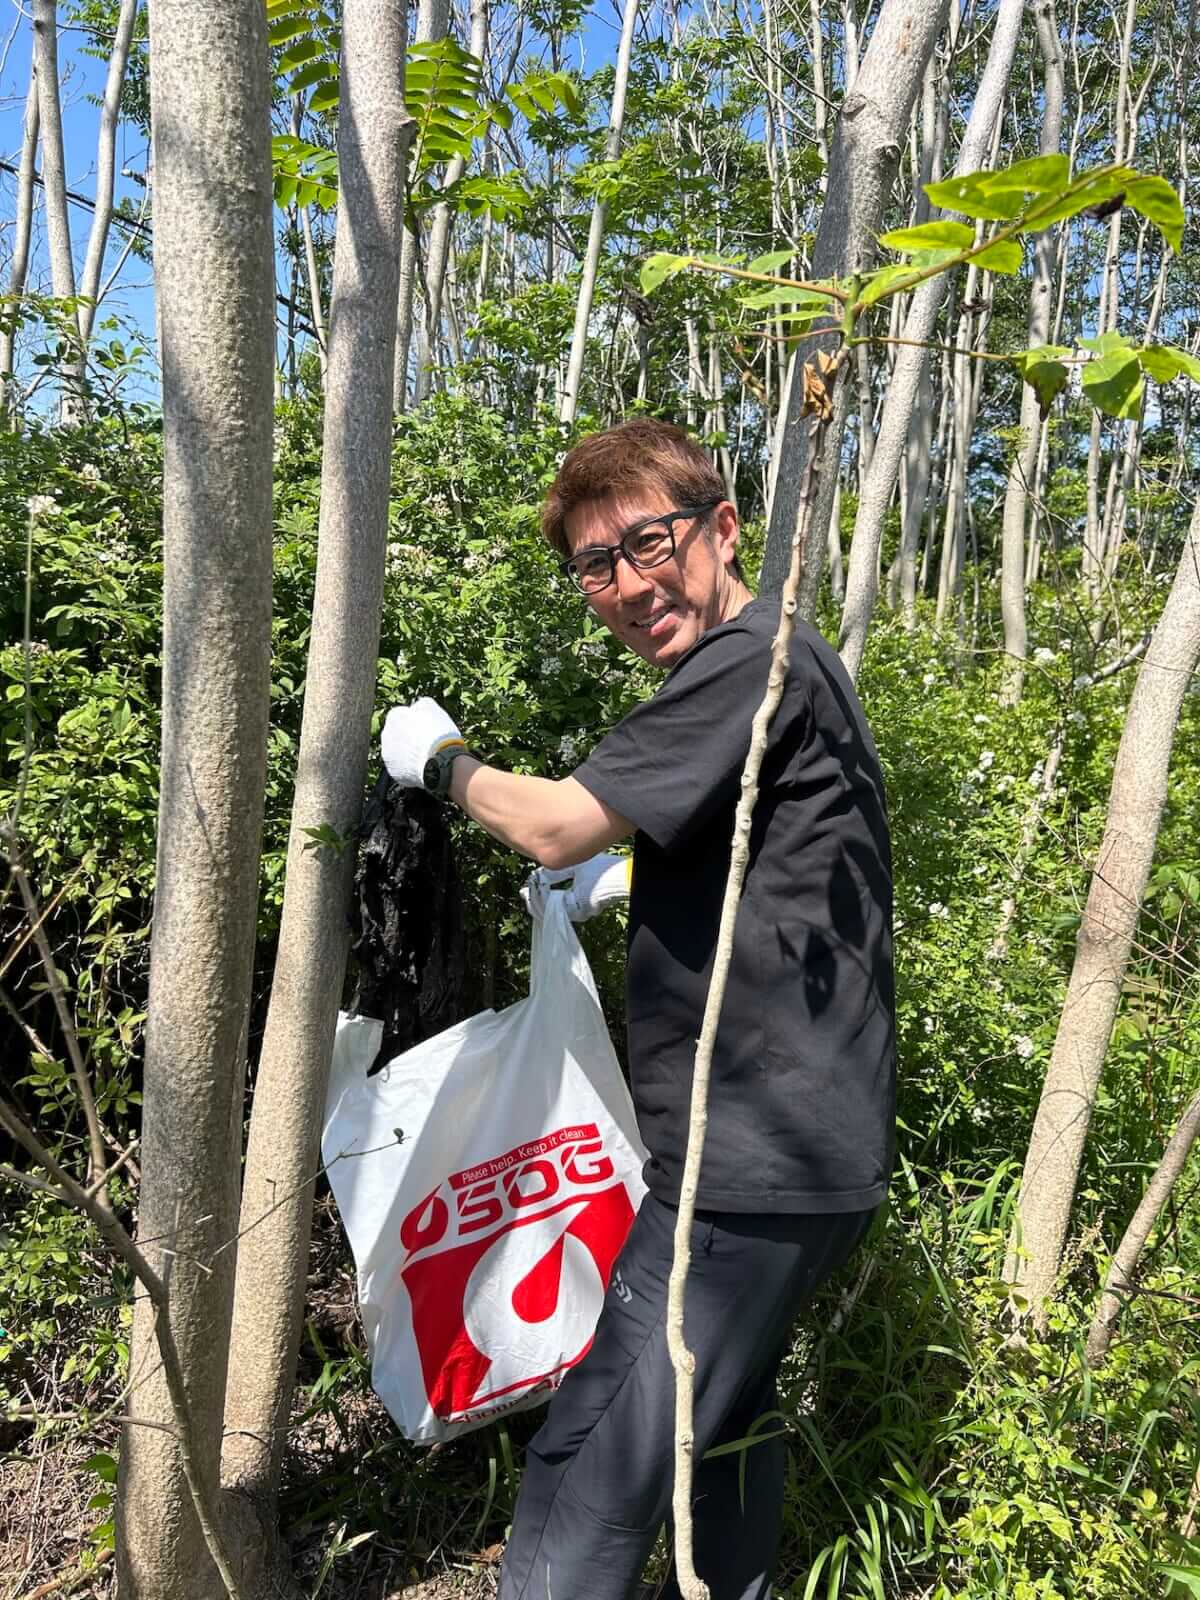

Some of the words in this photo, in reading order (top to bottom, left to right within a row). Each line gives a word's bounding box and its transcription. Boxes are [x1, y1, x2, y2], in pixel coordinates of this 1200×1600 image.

[462, 1168, 488, 1184] Please
[490, 1156, 517, 1173] help.
[518, 1142, 547, 1159] Keep
[549, 1136, 558, 1147] it
